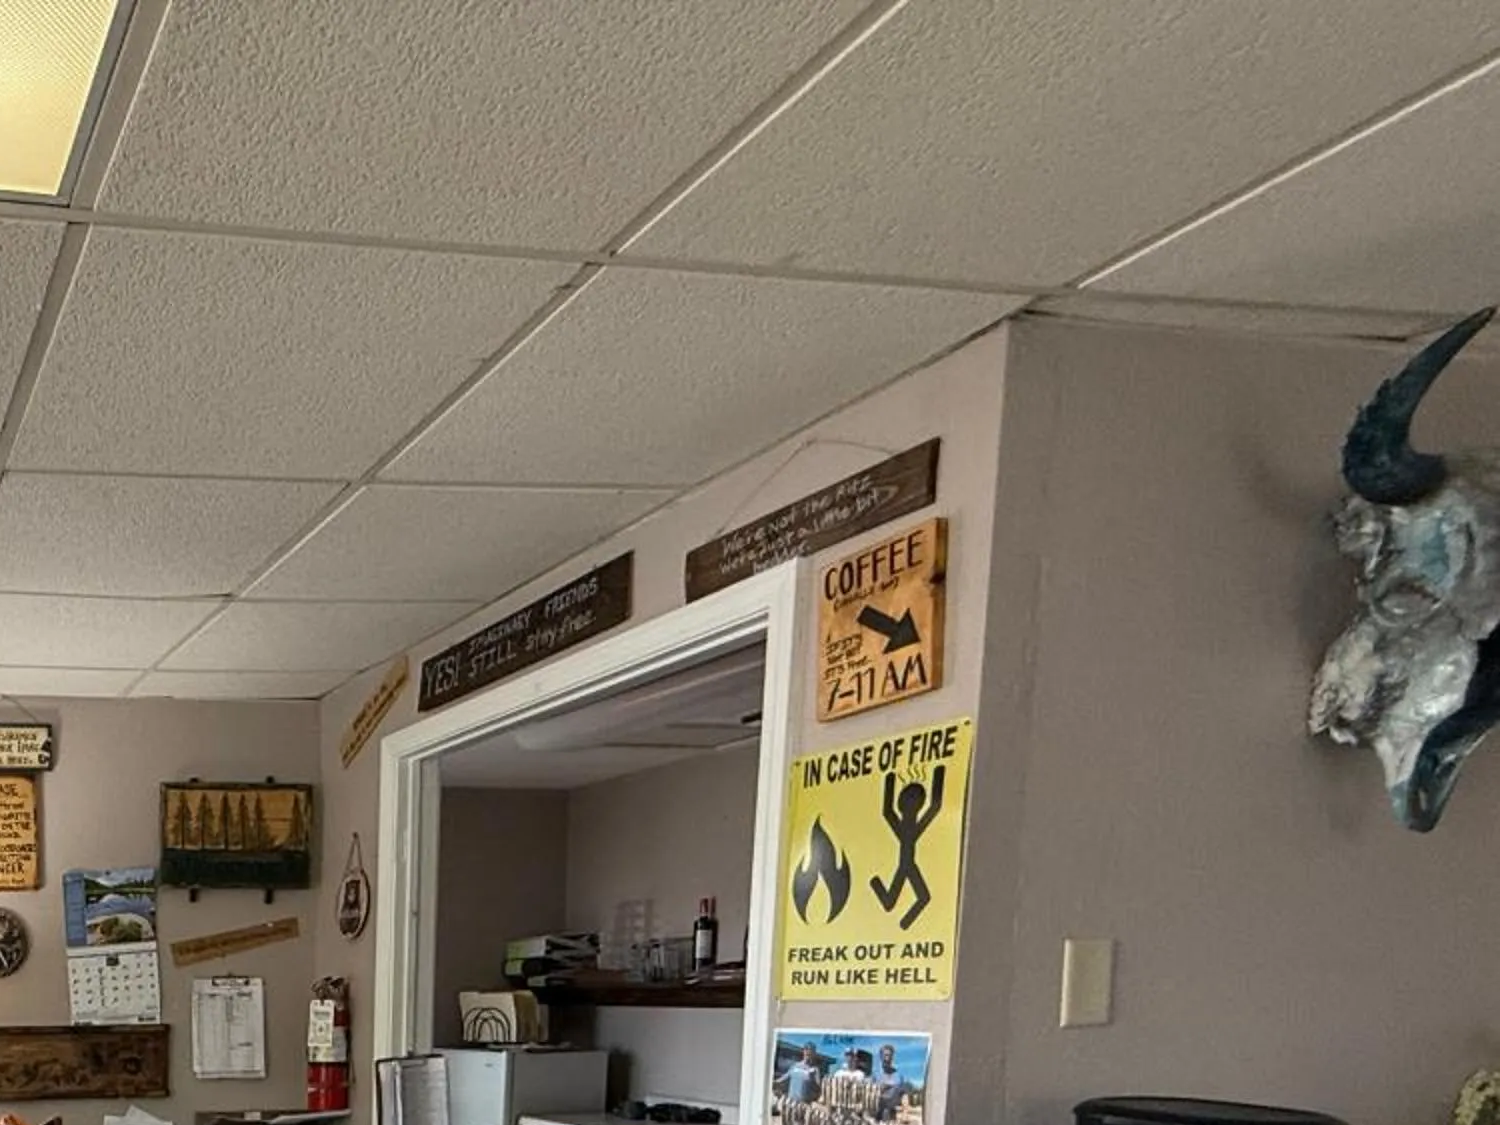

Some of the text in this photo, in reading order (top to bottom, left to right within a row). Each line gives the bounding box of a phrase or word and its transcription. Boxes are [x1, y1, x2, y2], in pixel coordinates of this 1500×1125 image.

[824, 529, 924, 600] COFFEE
[425, 653, 460, 698] YES!
[544, 577, 599, 619] FRIENDS
[468, 640, 517, 679] STILL
[881, 652, 928, 697] AM
[803, 724, 958, 789] IN CASE OF FIRE
[788, 941, 945, 963] FREAK OUT AND
[790, 966, 938, 986] RUN LIKE HELL
